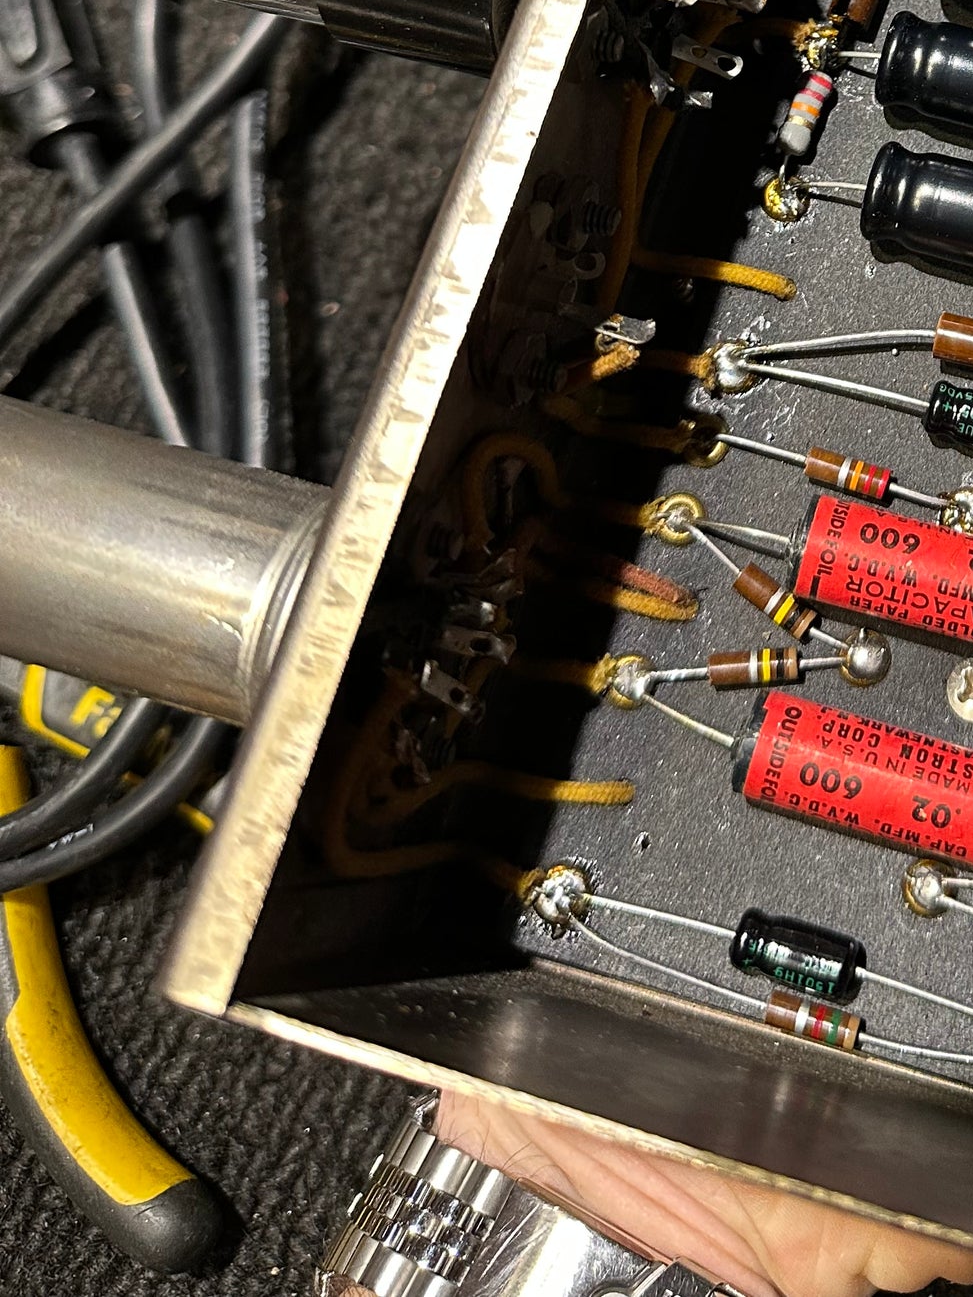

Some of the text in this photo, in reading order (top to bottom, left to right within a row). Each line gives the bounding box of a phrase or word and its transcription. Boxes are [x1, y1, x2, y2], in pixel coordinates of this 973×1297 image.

[859, 522, 921, 555] 600
[850, 597, 909, 621] PAPER
[816, 714, 881, 749] CORP.
[815, 734, 971, 794] MADE IN U.S.A.
[799, 762, 962, 829] .02 600
